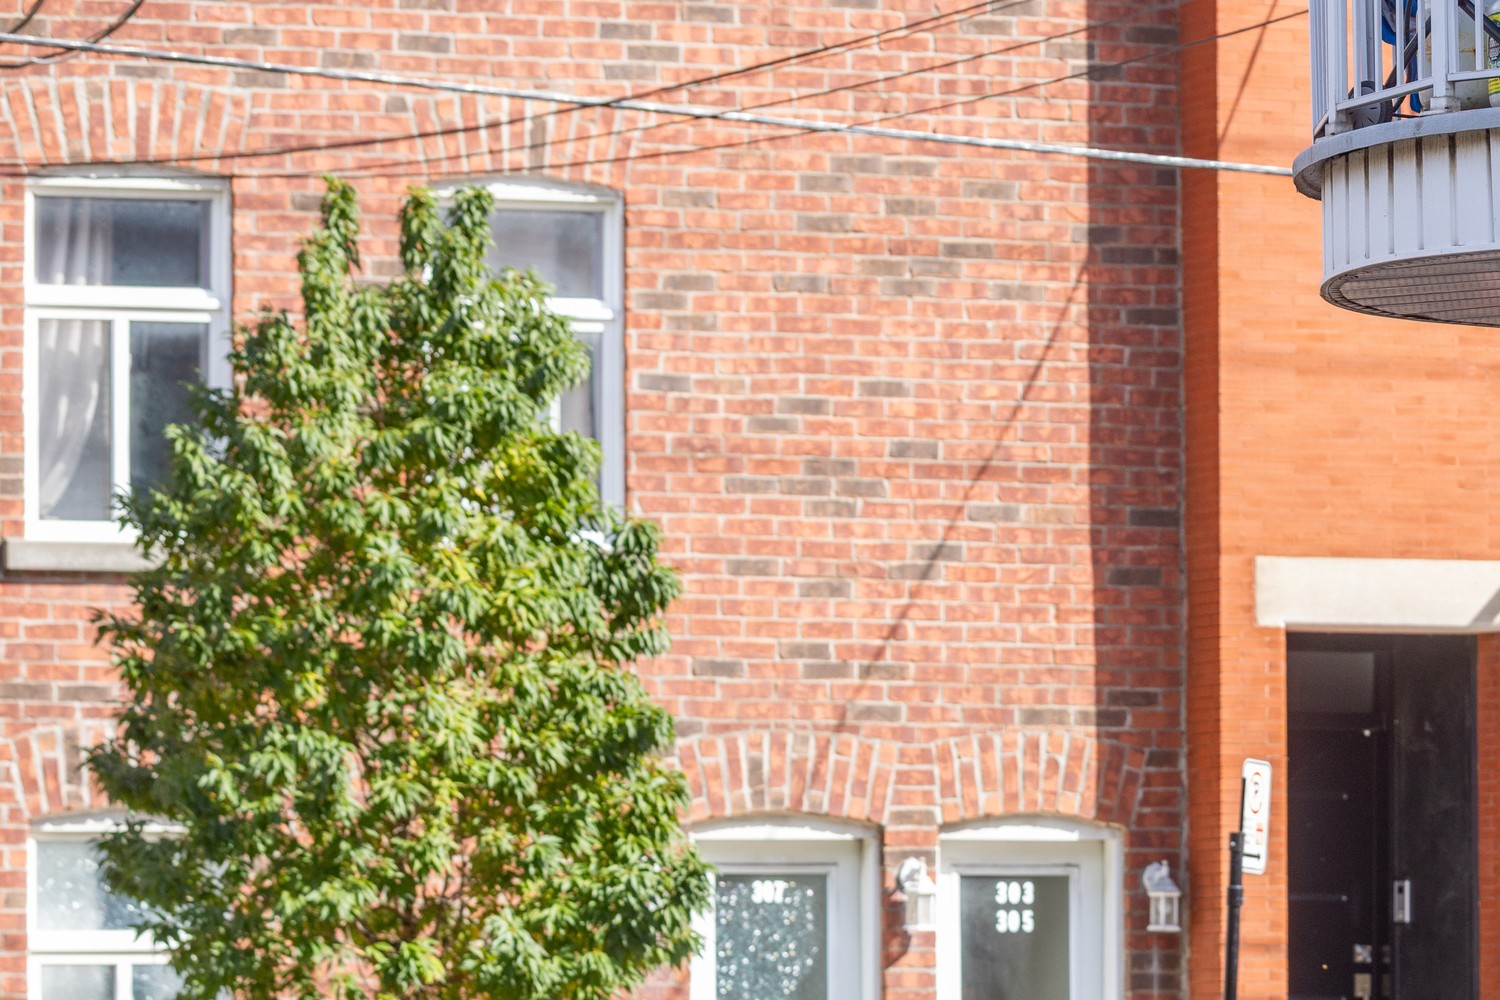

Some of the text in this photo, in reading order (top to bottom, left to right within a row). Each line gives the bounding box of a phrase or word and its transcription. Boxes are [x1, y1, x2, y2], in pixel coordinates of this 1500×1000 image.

[751, 880, 788, 904] 307
[995, 881, 1035, 905] 303
[995, 909, 1035, 933] 305
